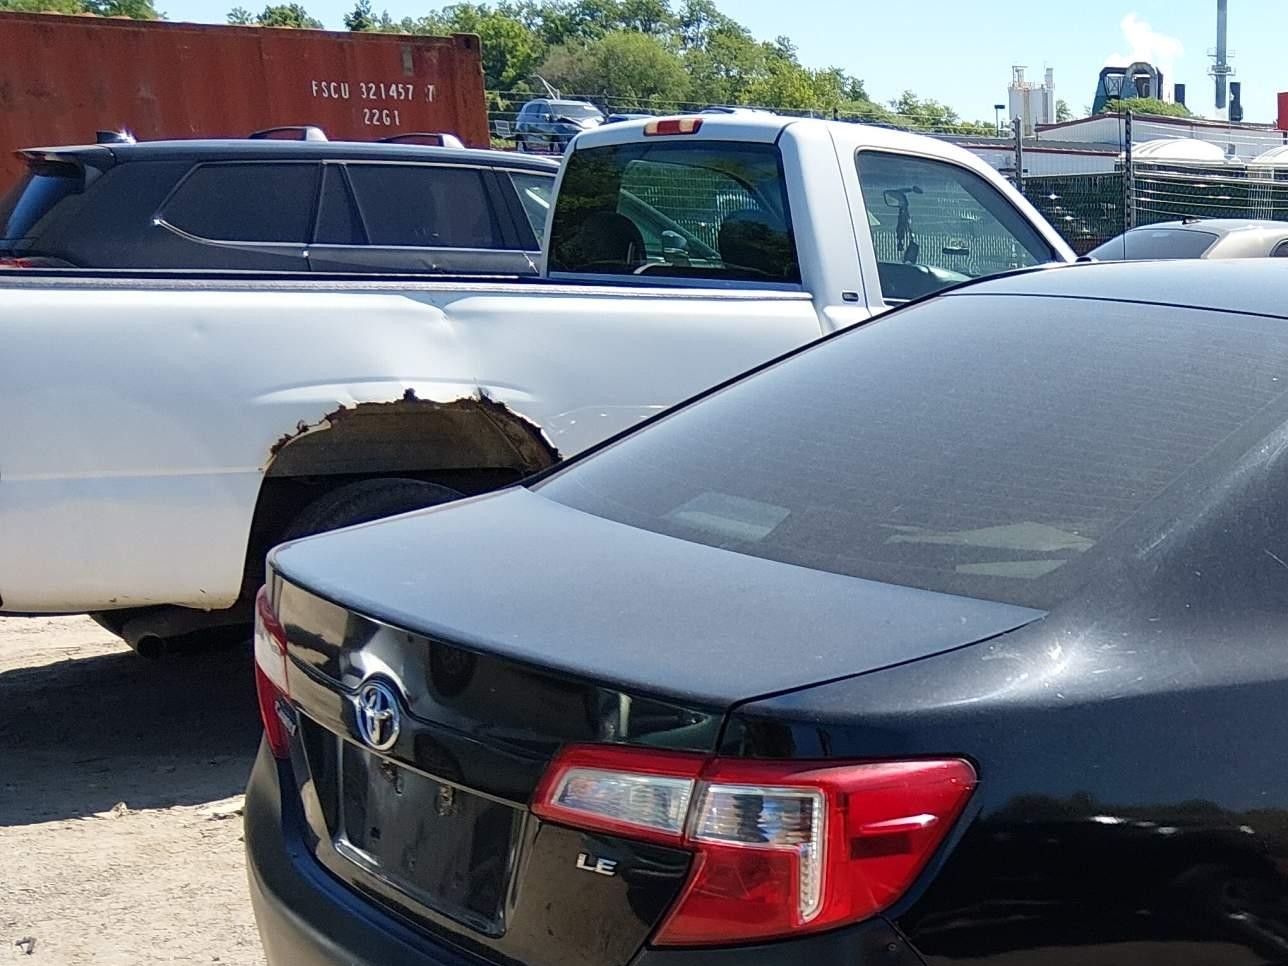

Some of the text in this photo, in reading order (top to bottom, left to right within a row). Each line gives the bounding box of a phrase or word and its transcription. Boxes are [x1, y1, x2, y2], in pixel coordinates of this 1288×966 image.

[311, 80, 436, 102] FSCU 321457 7
[363, 108, 400, 126] 22G1
[575, 852, 618, 876] LE
